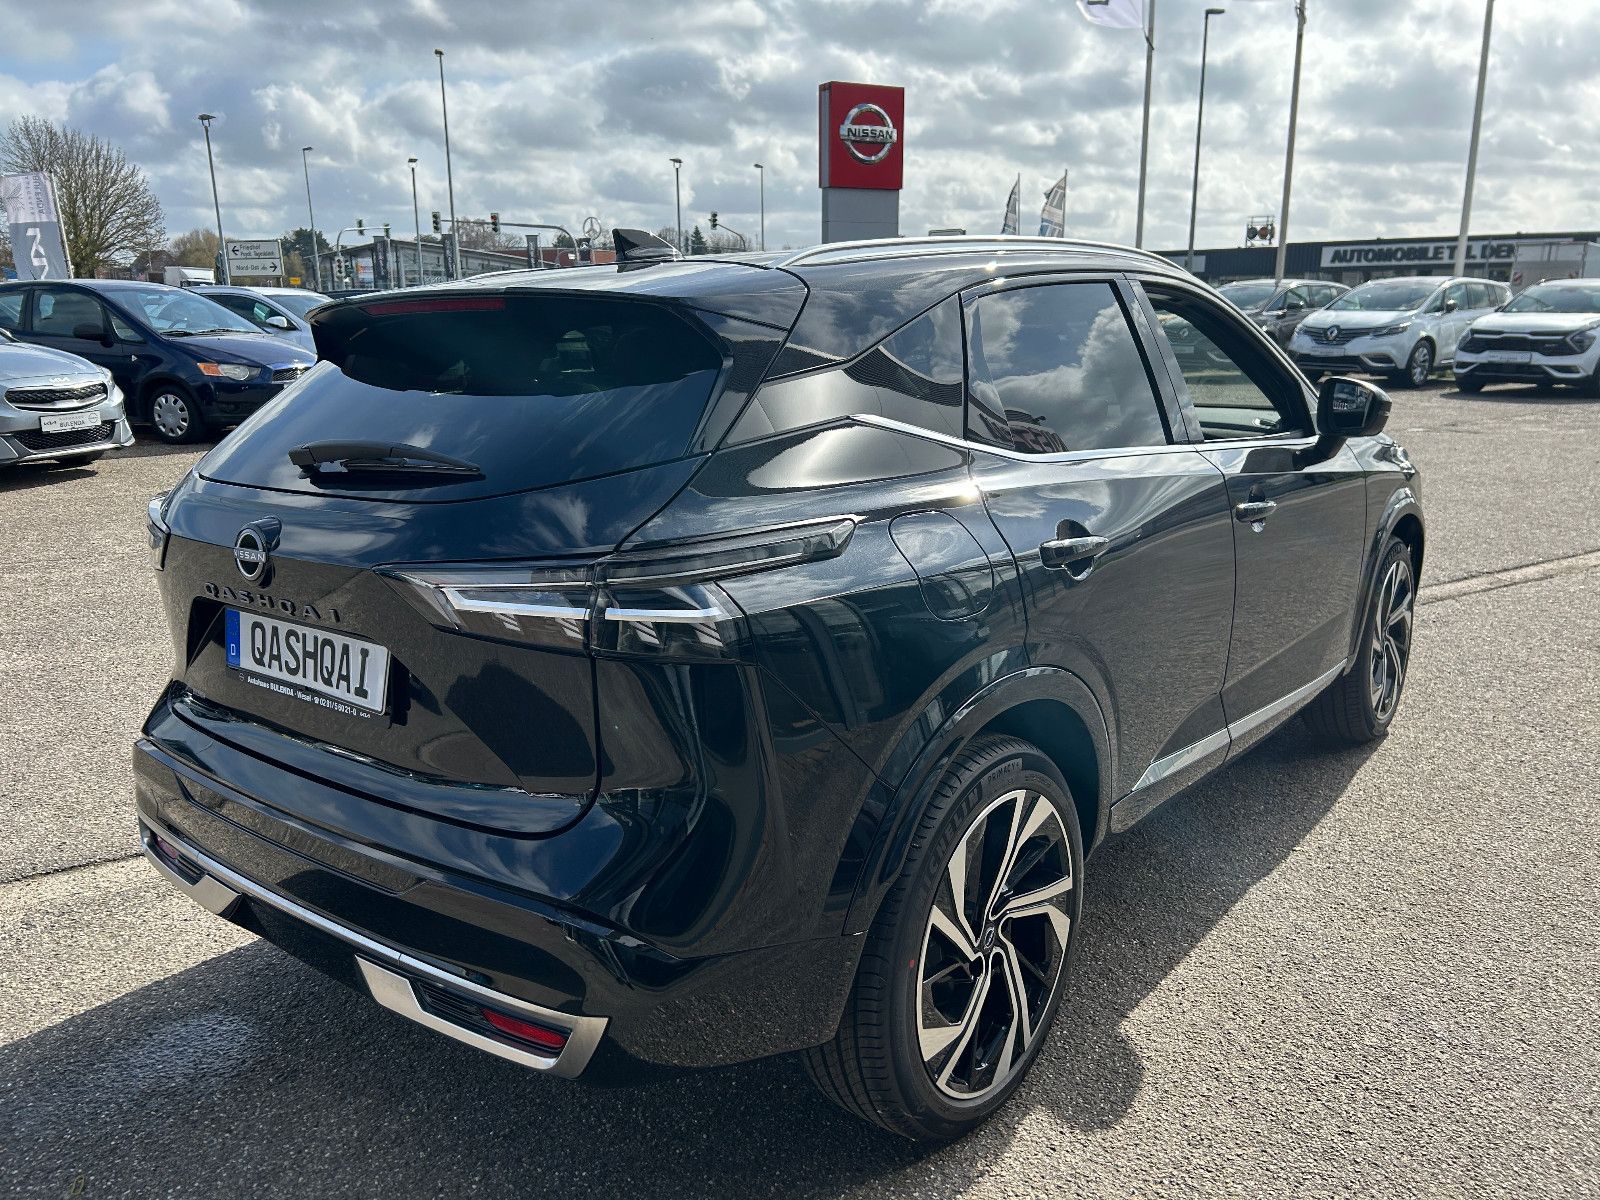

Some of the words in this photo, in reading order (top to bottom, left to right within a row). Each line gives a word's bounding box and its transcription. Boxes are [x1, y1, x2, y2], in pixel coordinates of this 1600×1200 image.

[847, 127, 894, 140] NISSAN
[1330, 244, 1444, 263] AUTOMOBILE
[234, 548, 265, 562] NISSAN
[204, 582, 341, 623] QASHQAI
[230, 643, 236, 656] D
[251, 620, 369, 700] QASHQAI
[247, 675, 270, 689] Autohaus
[270, 682, 294, 697] BULENDA
[296, 690, 312, 702] Wesel
